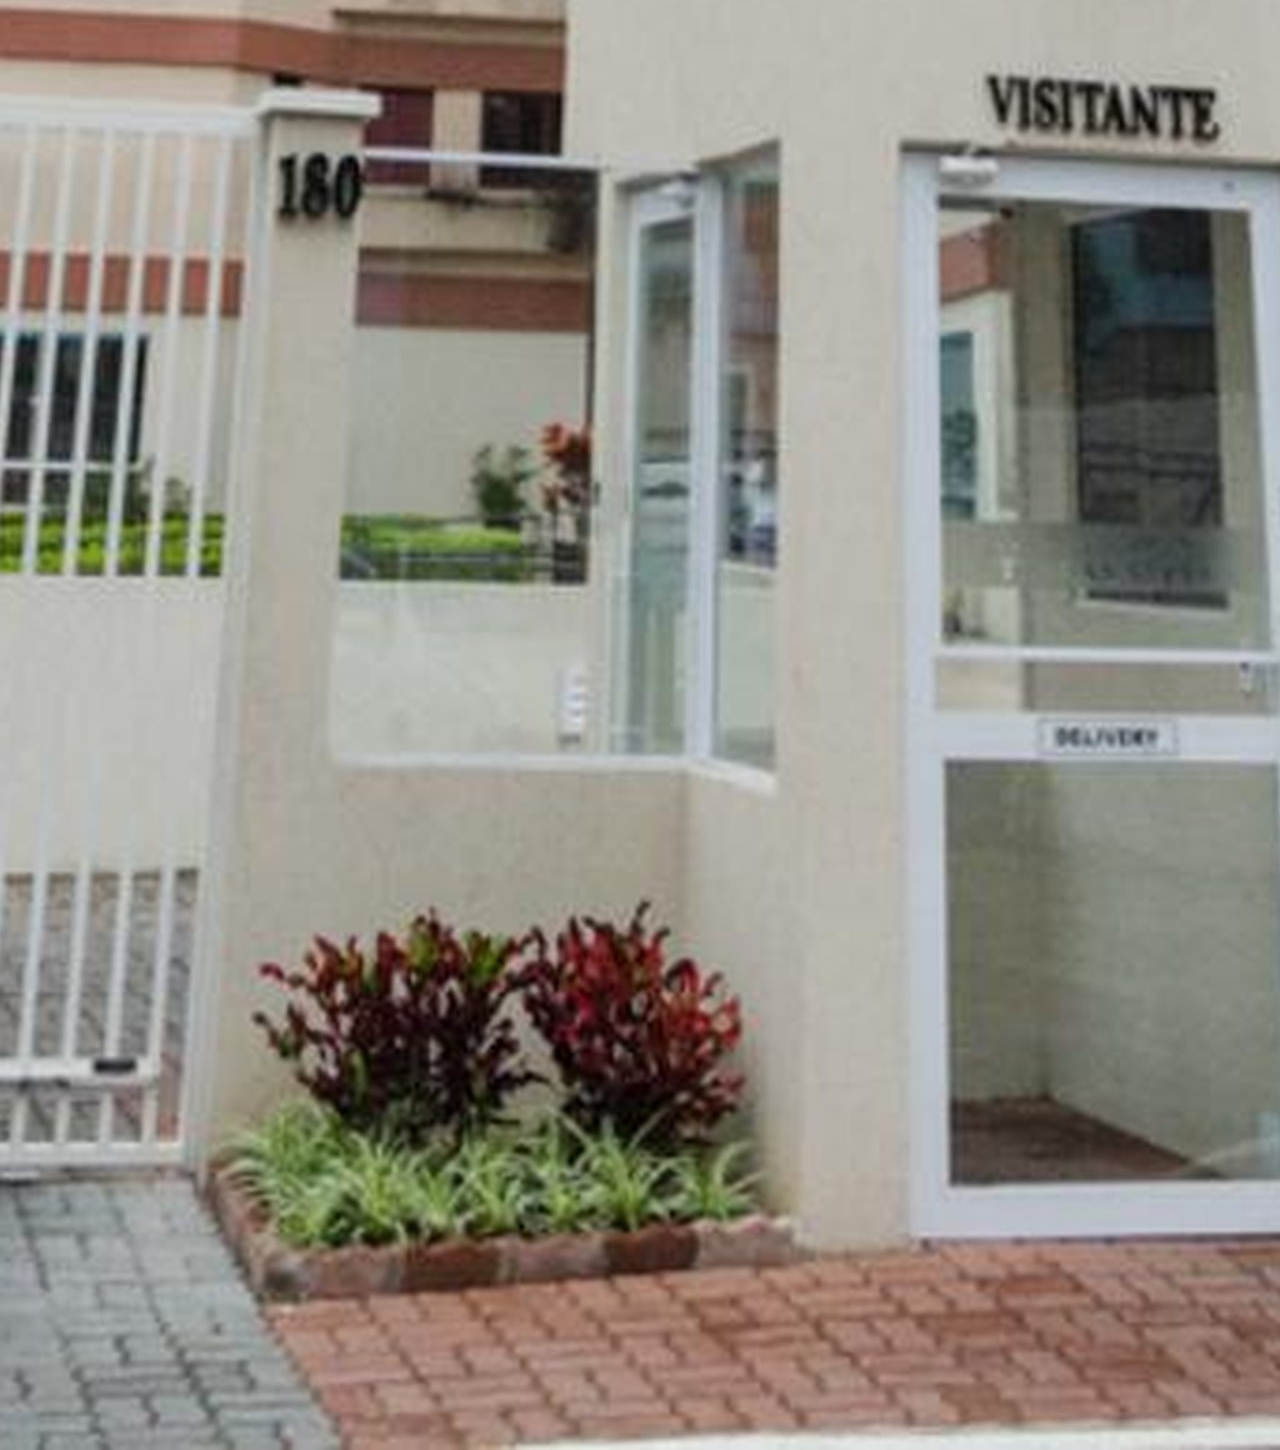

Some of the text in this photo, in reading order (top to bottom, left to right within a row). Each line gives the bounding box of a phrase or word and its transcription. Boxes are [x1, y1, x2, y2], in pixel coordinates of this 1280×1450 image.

[986, 75, 1222, 140] VISITANTE
[278, 152, 363, 220] 180
[1055, 726, 1158, 747] DELIVERY
